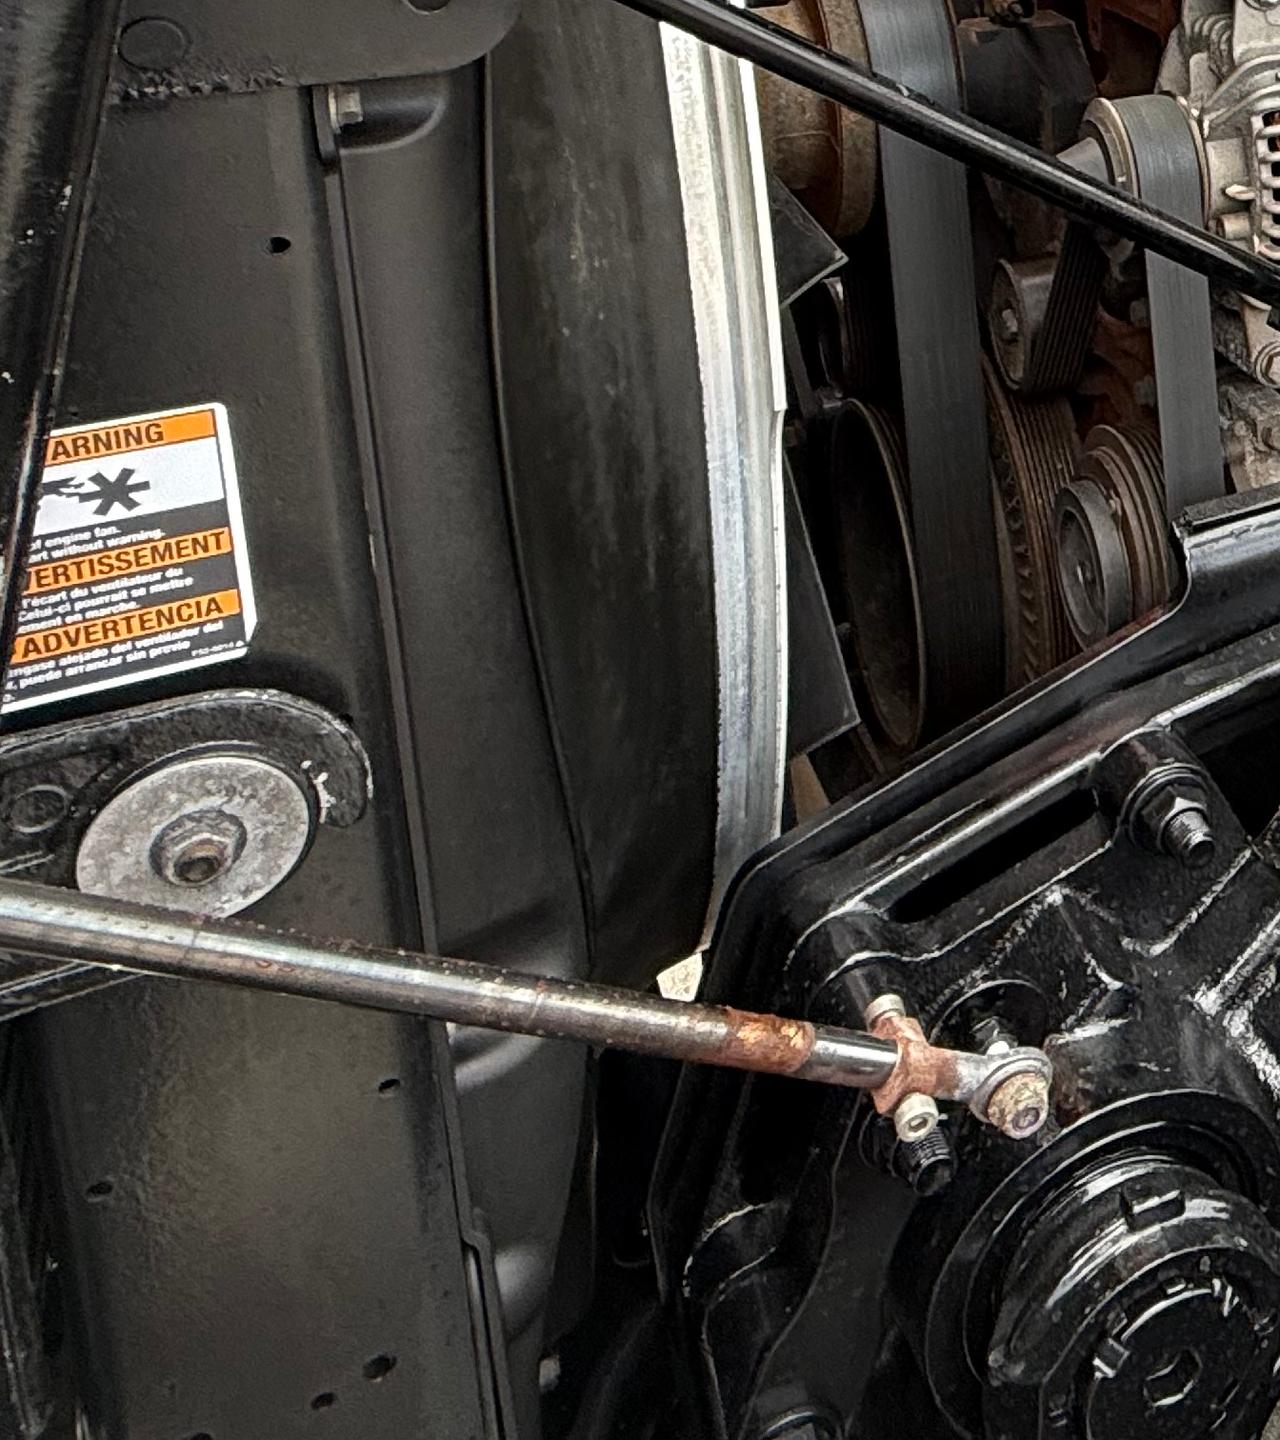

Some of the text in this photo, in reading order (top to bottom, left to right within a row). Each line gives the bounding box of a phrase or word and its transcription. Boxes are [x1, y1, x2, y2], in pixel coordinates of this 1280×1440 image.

[51, 422, 164, 461] ARNING
[28, 528, 166, 563] art without warning.
[45, 528, 92, 548] engine
[70, 587, 88, 599] du
[91, 570, 164, 594] ventilateur
[165, 567, 184, 578] du
[74, 590, 129, 611] pourrait
[131, 586, 147, 598] se
[150, 576, 194, 594] mettre
[17, 616, 62, 634] ement
[67, 613, 84, 625] en
[21, 597, 224, 658] ADVERTENCIA
[7, 620, 224, 678] ngase alejado del ventilador del
[20, 670, 62, 690] puede
[65, 655, 123, 677] arrancar
[126, 648, 147, 663] sin
